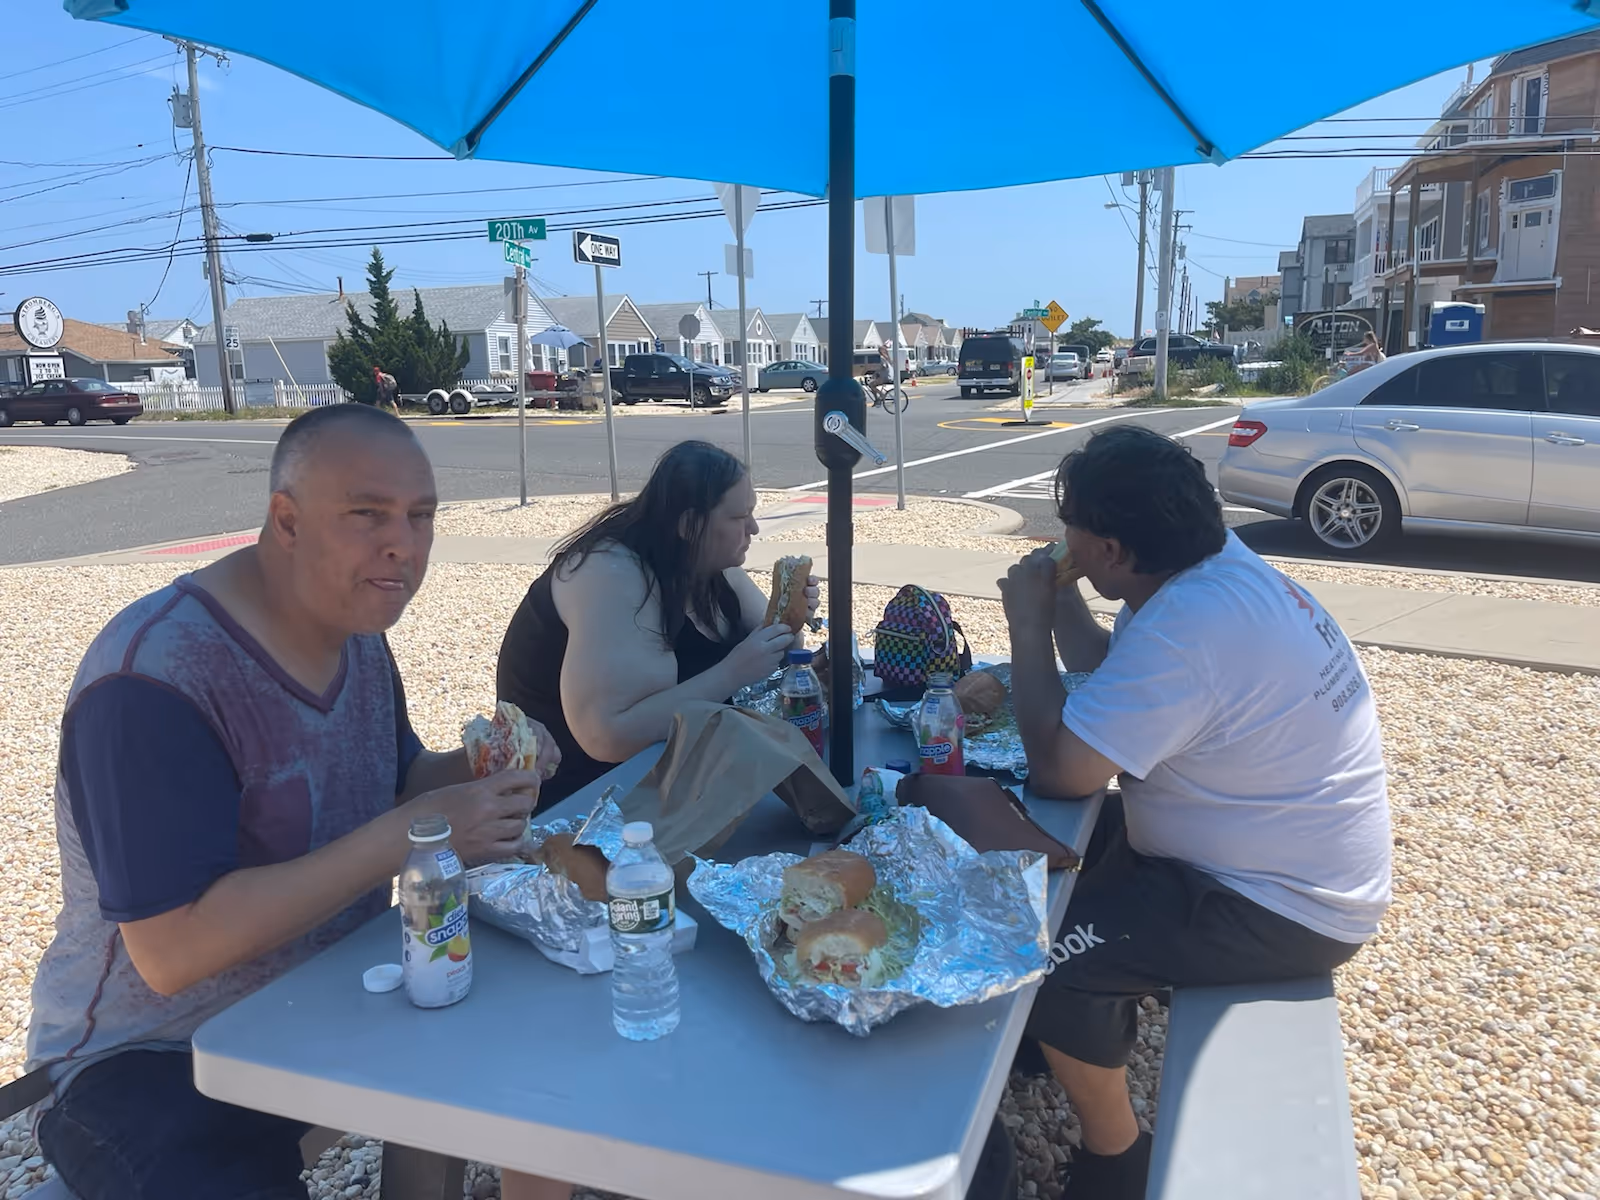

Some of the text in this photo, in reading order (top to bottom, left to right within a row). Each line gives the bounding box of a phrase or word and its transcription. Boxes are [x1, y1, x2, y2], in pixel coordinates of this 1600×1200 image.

[495, 222, 539, 240] 20Th Av
[505, 242, 525, 265] Central
[591, 242, 617, 257] ONE WAY
[226, 338, 239, 348] 25
[1313, 662, 1348, 700] PLUMBING
[447, 904, 464, 922] diet
